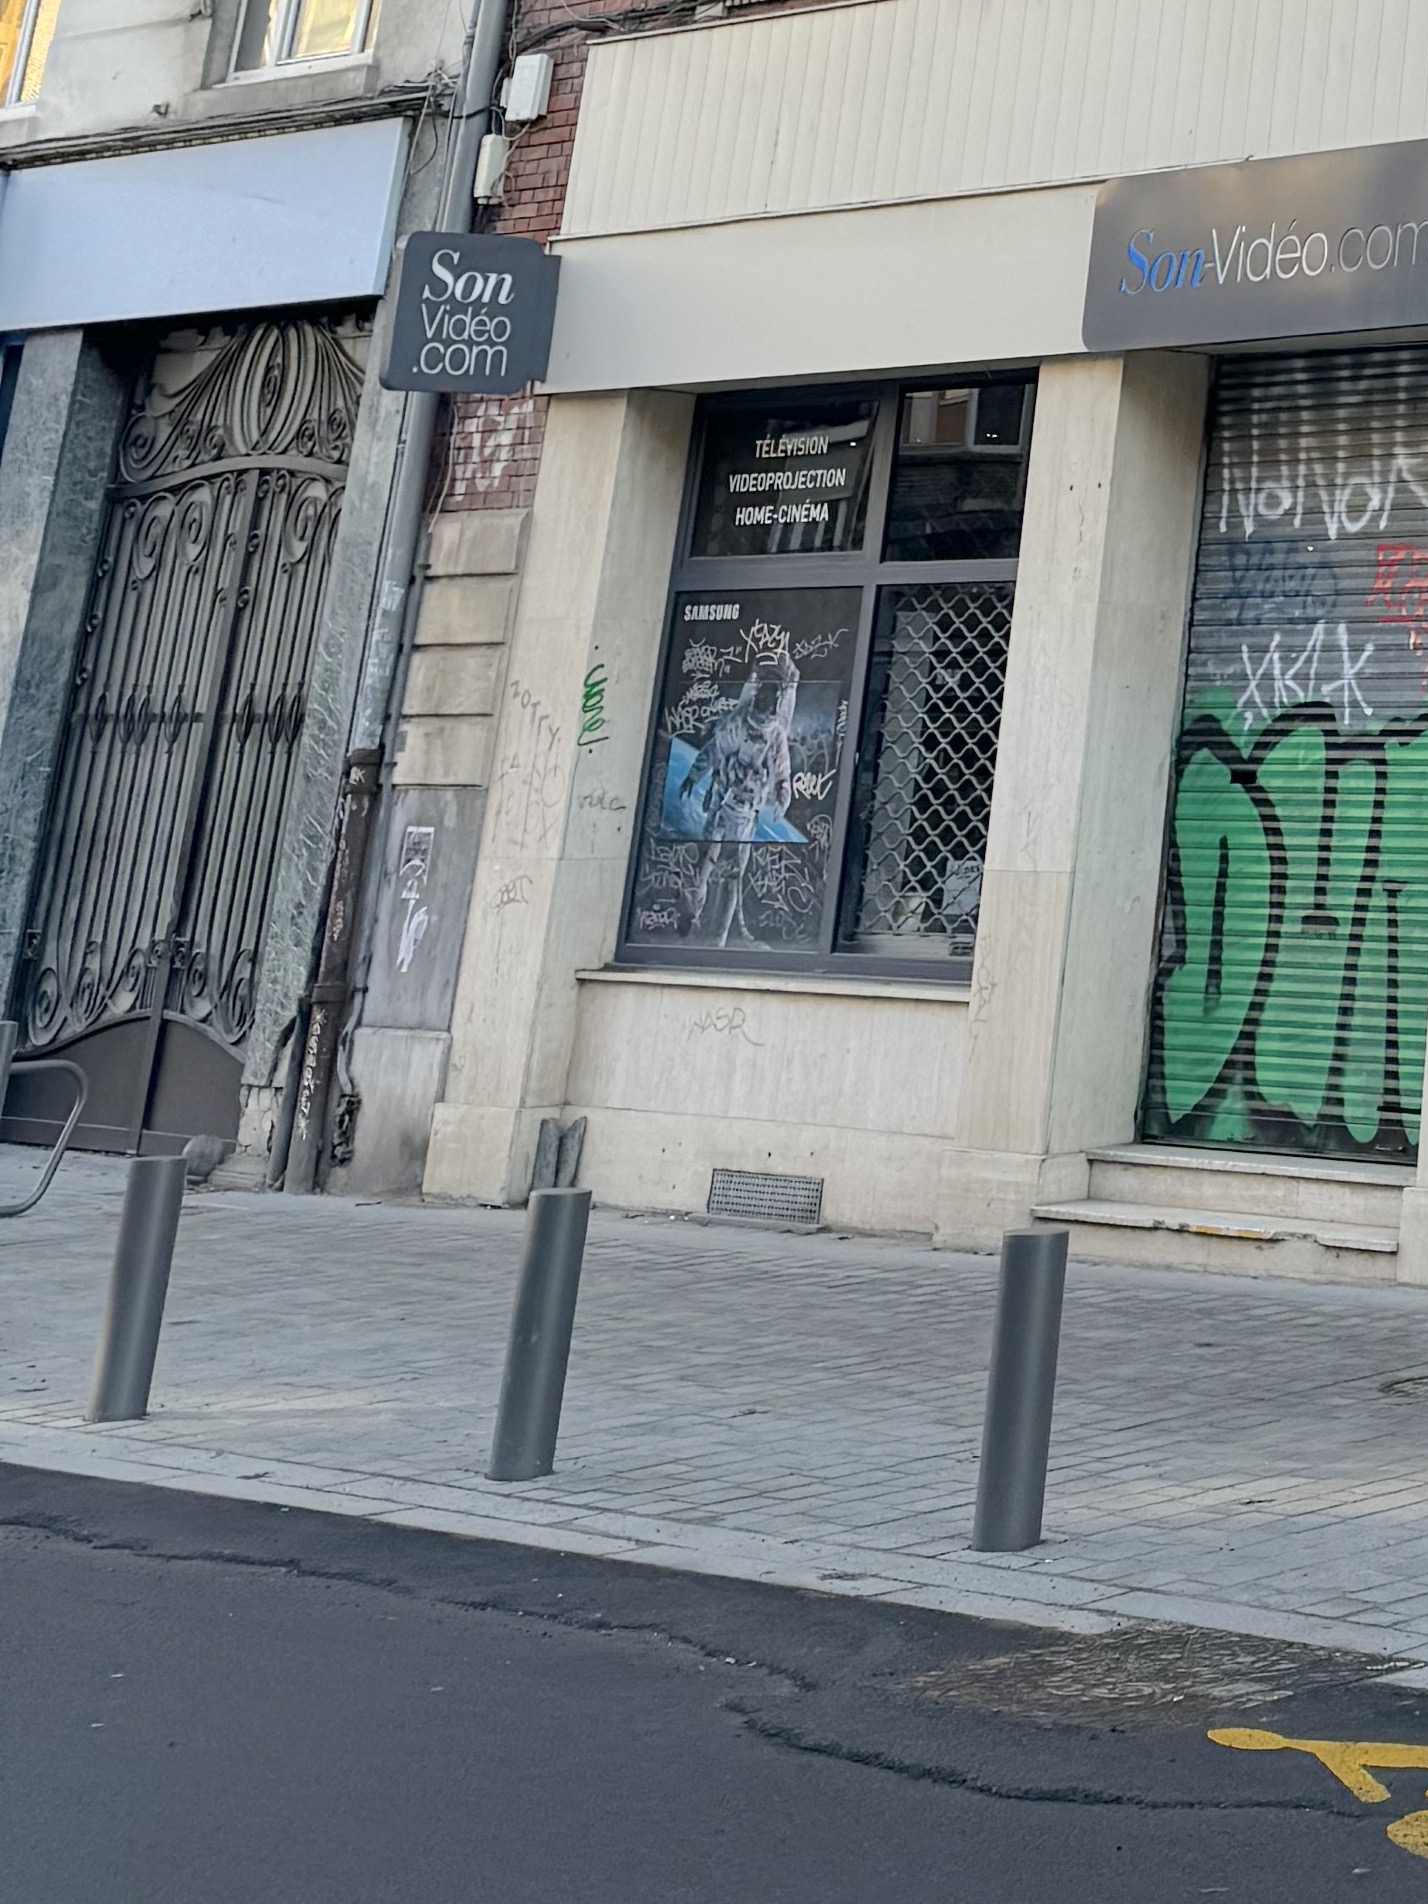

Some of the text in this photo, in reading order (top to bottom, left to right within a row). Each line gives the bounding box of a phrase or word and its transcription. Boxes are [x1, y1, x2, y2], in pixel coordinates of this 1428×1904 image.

[422, 249, 515, 305] Son
[421, 303, 511, 342] Vidéo
[412, 342, 508, 377] .com
[755, 433, 829, 459] TÉLÉVISION
[729, 468, 846, 493] VIDEOPROJECTION
[735, 498, 829, 526] HOME-CINÉMA
[683, 603, 740, 621] SAMSUNG
